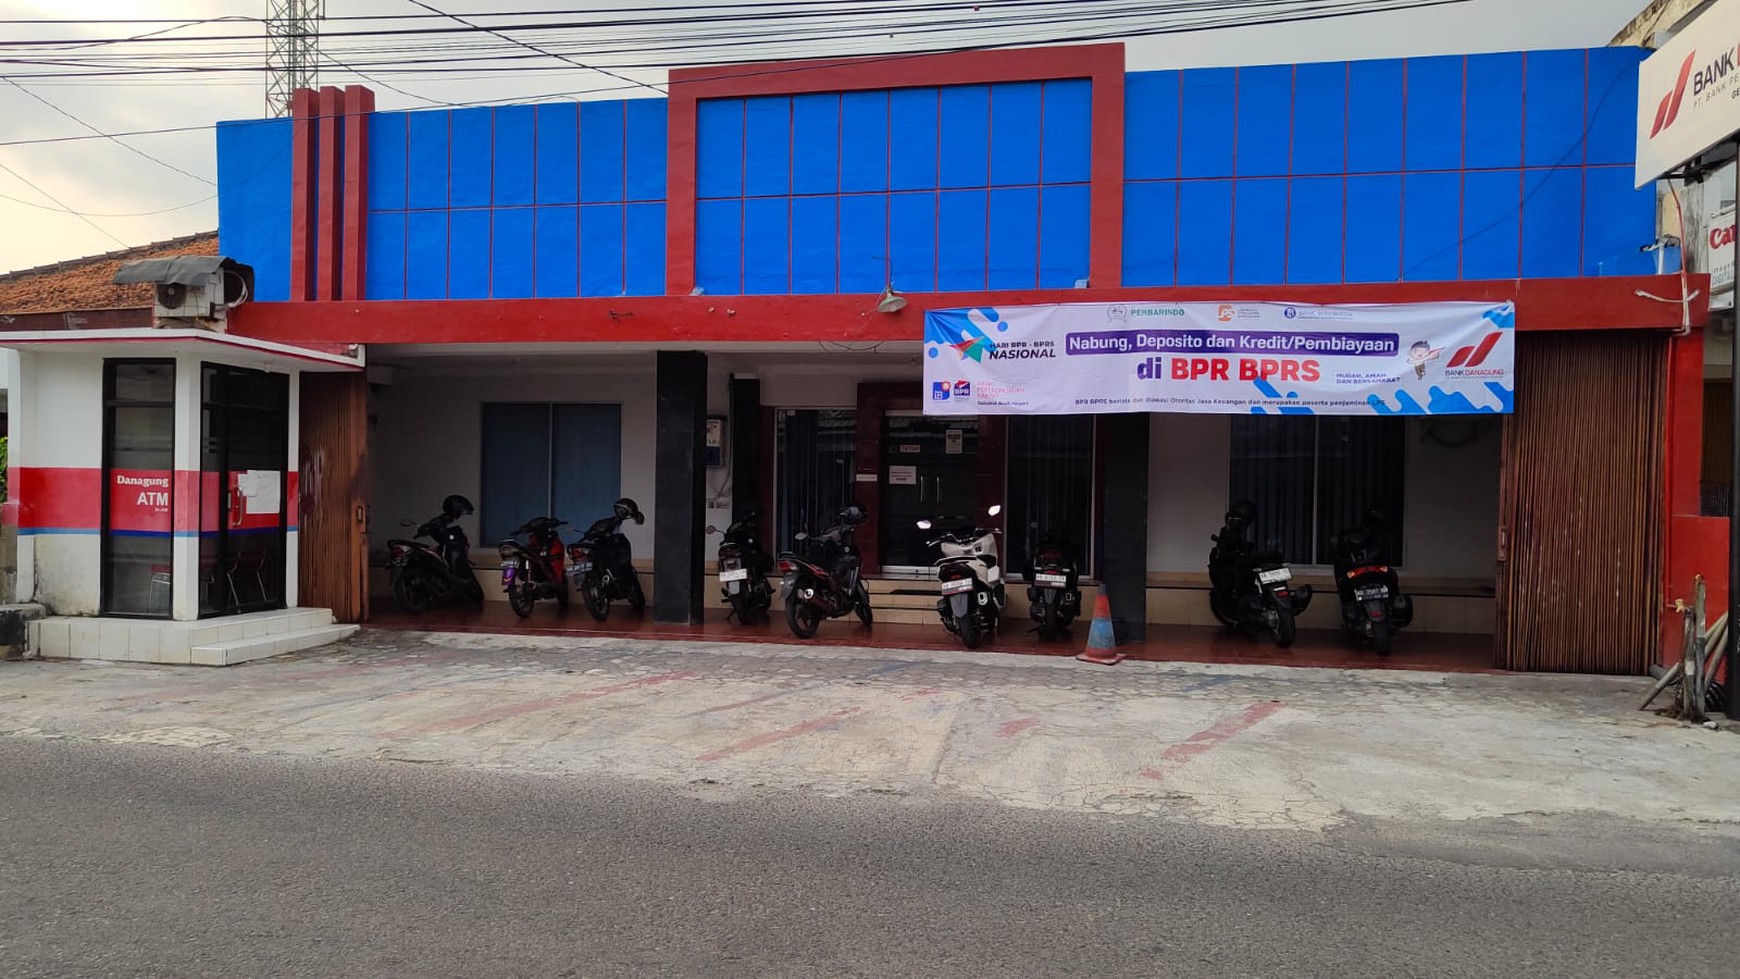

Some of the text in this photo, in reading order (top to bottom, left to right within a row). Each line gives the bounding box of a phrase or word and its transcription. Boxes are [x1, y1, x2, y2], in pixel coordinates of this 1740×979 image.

[1694, 47, 1734, 96] BANK
[1131, 308, 1185, 317] PERBARINDO
[990, 341, 1009, 349] HARI
[1069, 334, 1394, 354] Nabung, Deposito dan Kredit/Pembiayaan
[989, 348, 1057, 360] NASIONAL
[1137, 356, 1320, 382] di BPR BPRS
[117, 475, 169, 488] Danagung
[137, 492, 168, 506] ATM
